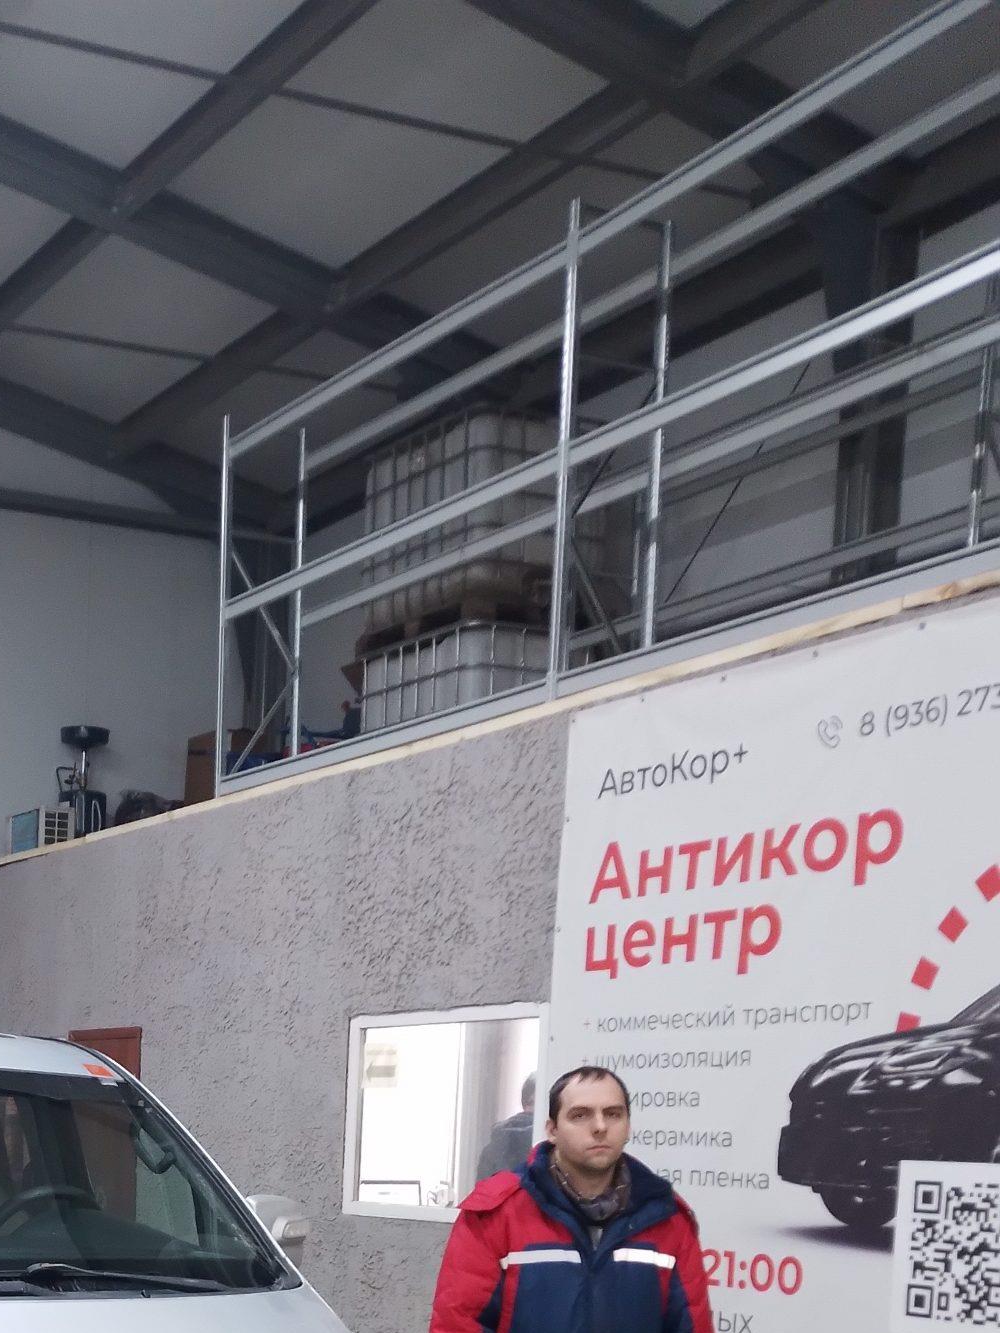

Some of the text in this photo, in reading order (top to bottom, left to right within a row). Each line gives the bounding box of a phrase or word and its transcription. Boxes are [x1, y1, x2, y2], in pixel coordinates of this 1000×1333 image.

[859, 711, 875, 737] 8
[886, 694, 948, 737] (936)
[598, 743, 748, 799] АвтоКор+
[589, 808, 903, 904] Антикор
[584, 903, 782, 980] центр
[597, 1001, 871, 1033] коммеческий транспорт
[689, 1168, 770, 1189] пленка
